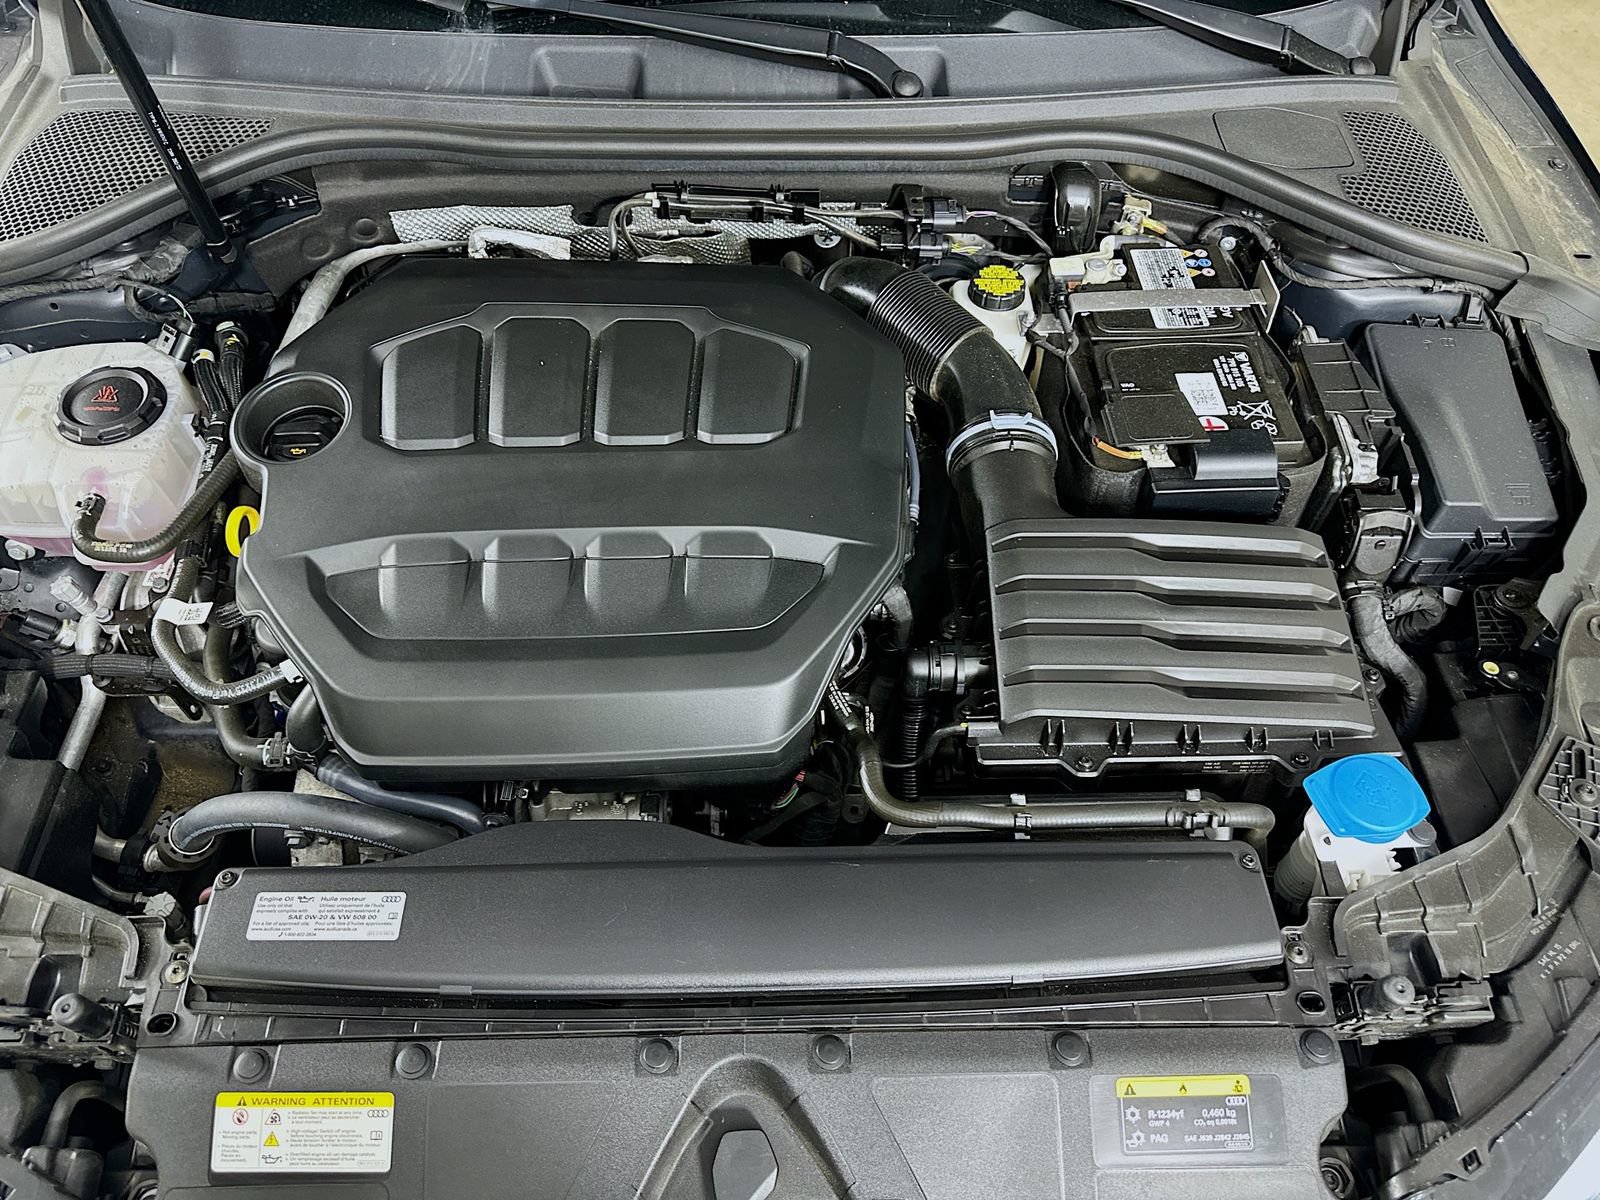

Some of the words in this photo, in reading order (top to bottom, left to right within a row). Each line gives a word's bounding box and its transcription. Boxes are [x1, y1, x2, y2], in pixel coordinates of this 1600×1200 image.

[1240, 362, 1261, 393] VARTA
[1228, 406, 1238, 416] Pb
[1537, 955, 1551, 966] SAE
[1148, 1109, 1185, 1120] R-1234yf
[1226, 1108, 1236, 1118] kg
[1150, 1133, 1169, 1143] PAG
